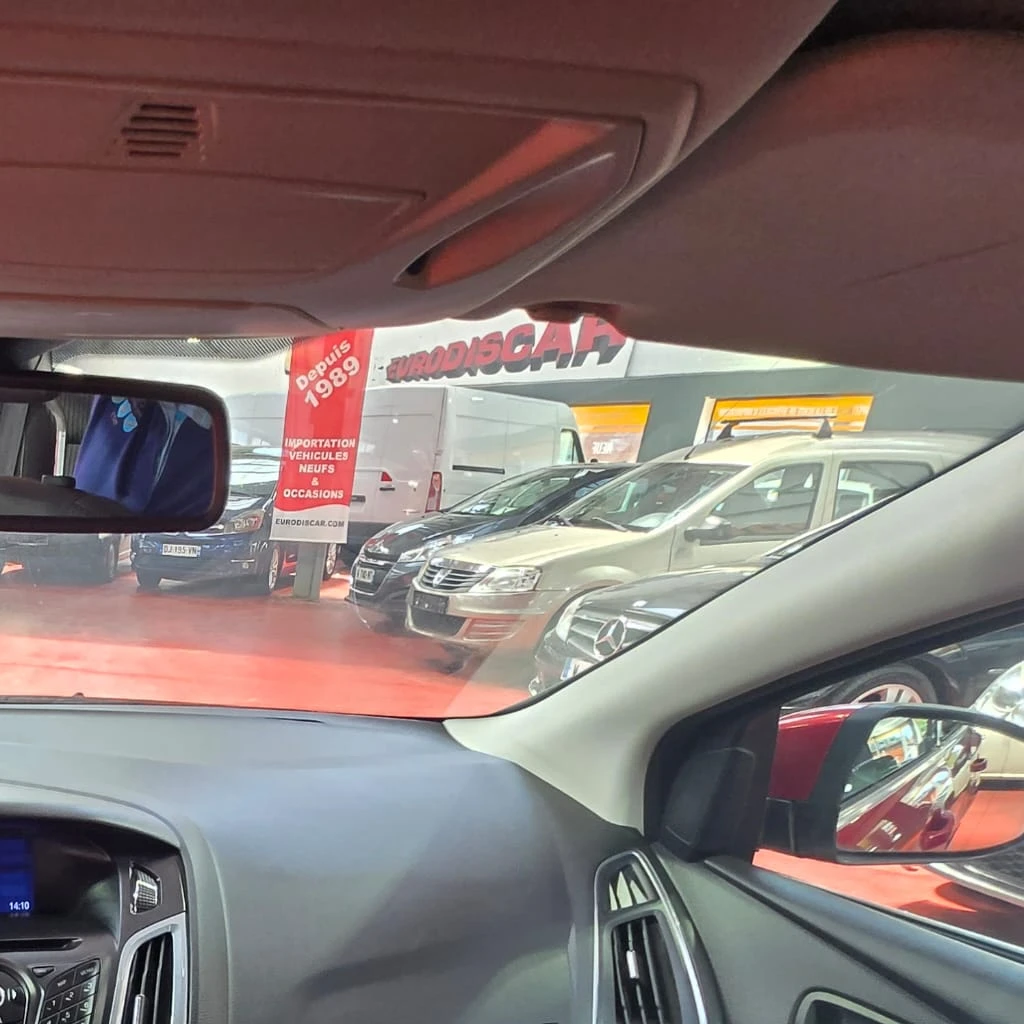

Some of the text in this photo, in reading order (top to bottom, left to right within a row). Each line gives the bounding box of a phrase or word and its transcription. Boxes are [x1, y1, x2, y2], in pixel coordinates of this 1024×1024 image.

[295, 340, 352, 391] Depuis
[304, 355, 360, 408] 1989
[284, 438, 356, 449] IMPORTATION
[289, 451, 349, 460] VEHICULES
[299, 464, 335, 474] NEUFS
[311, 477, 319, 486] &
[283, 489, 344, 499] OCCASIONS
[275, 518, 345, 528] EURODISCAR.COM
[9, 901, 30, 911] 14:10
